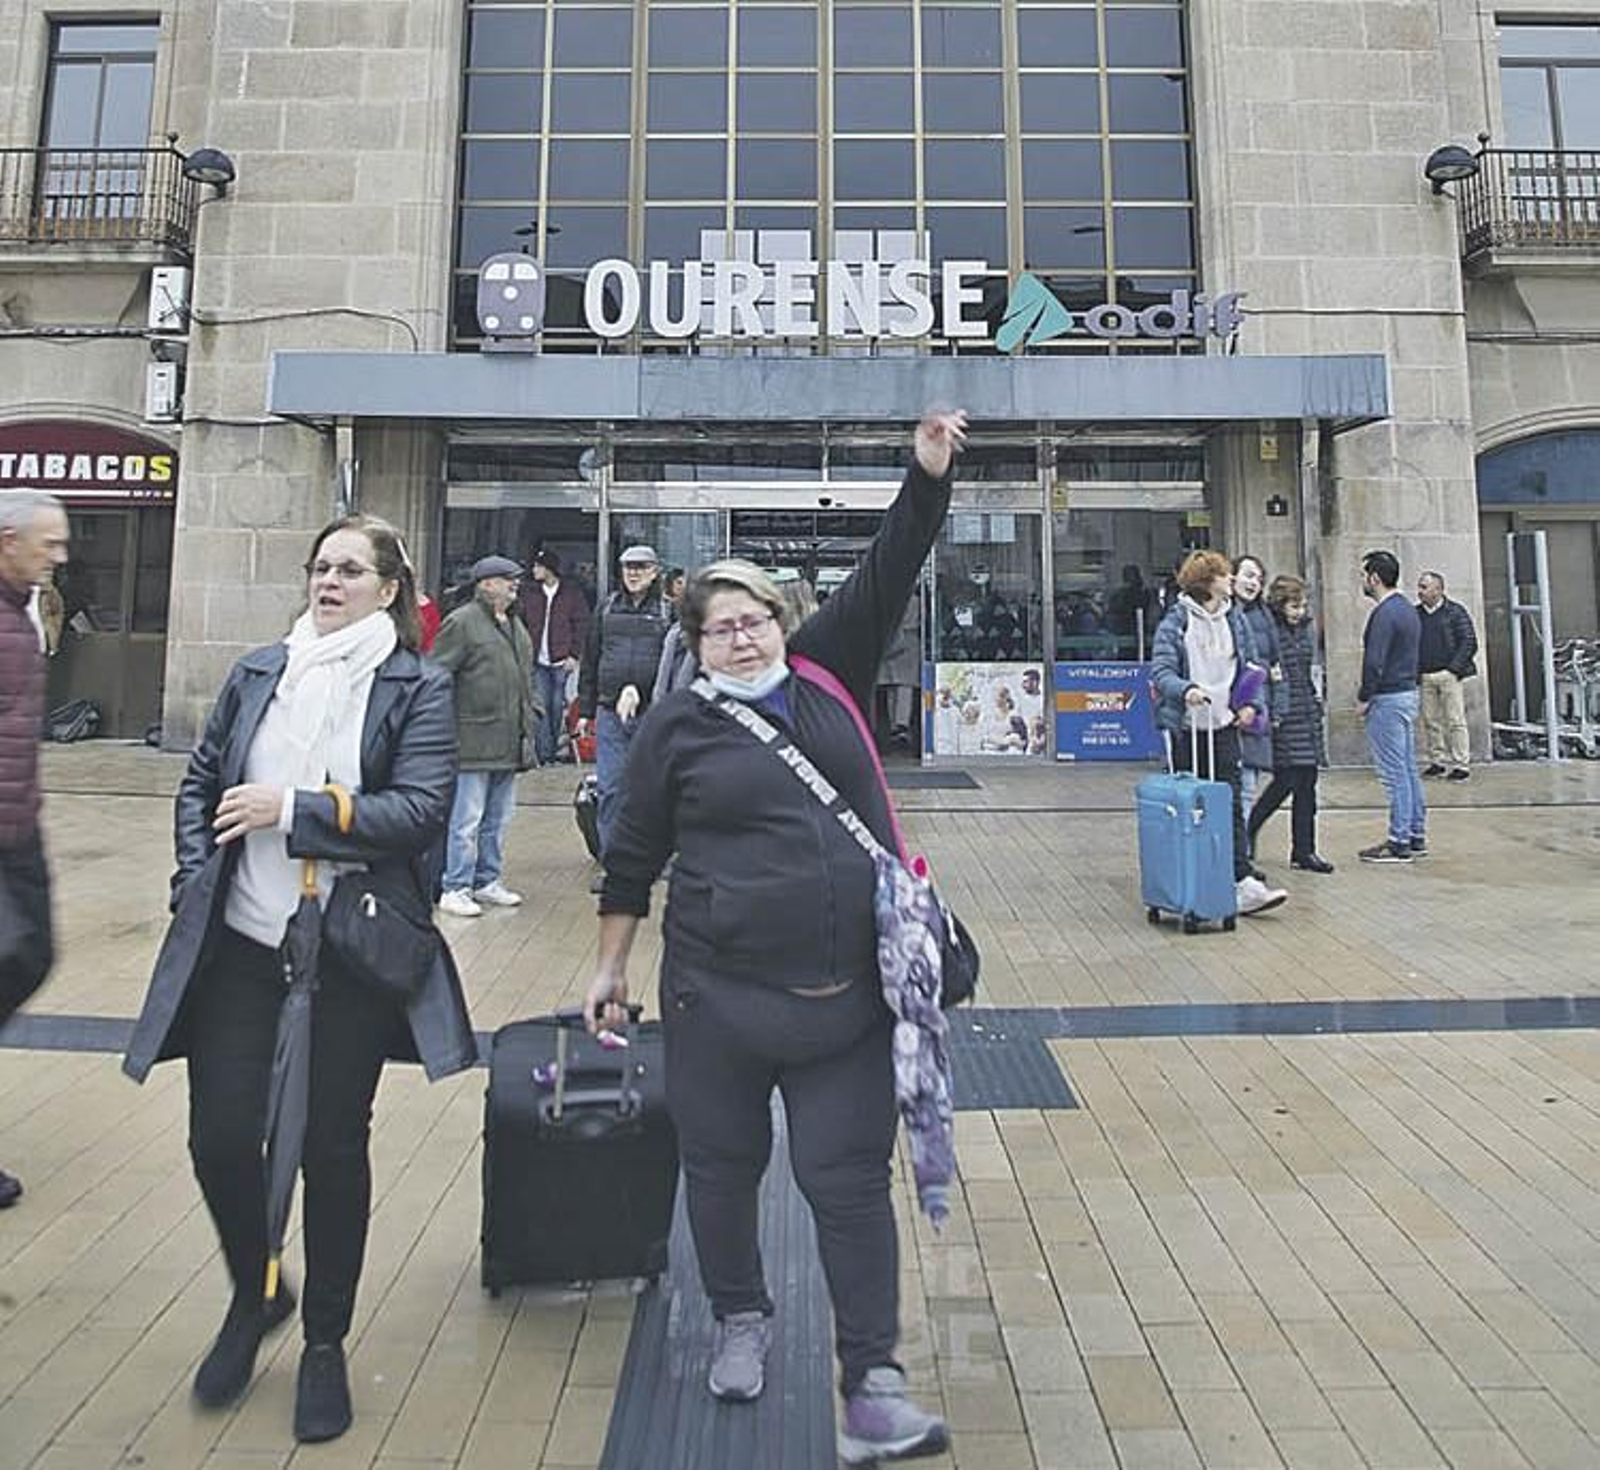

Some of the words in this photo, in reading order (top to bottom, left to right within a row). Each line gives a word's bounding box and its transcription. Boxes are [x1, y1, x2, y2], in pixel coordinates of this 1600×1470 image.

[584, 259, 989, 337] OURENSE
[1085, 289, 1245, 337] adif
[0, 453, 172, 481] TABACOS
